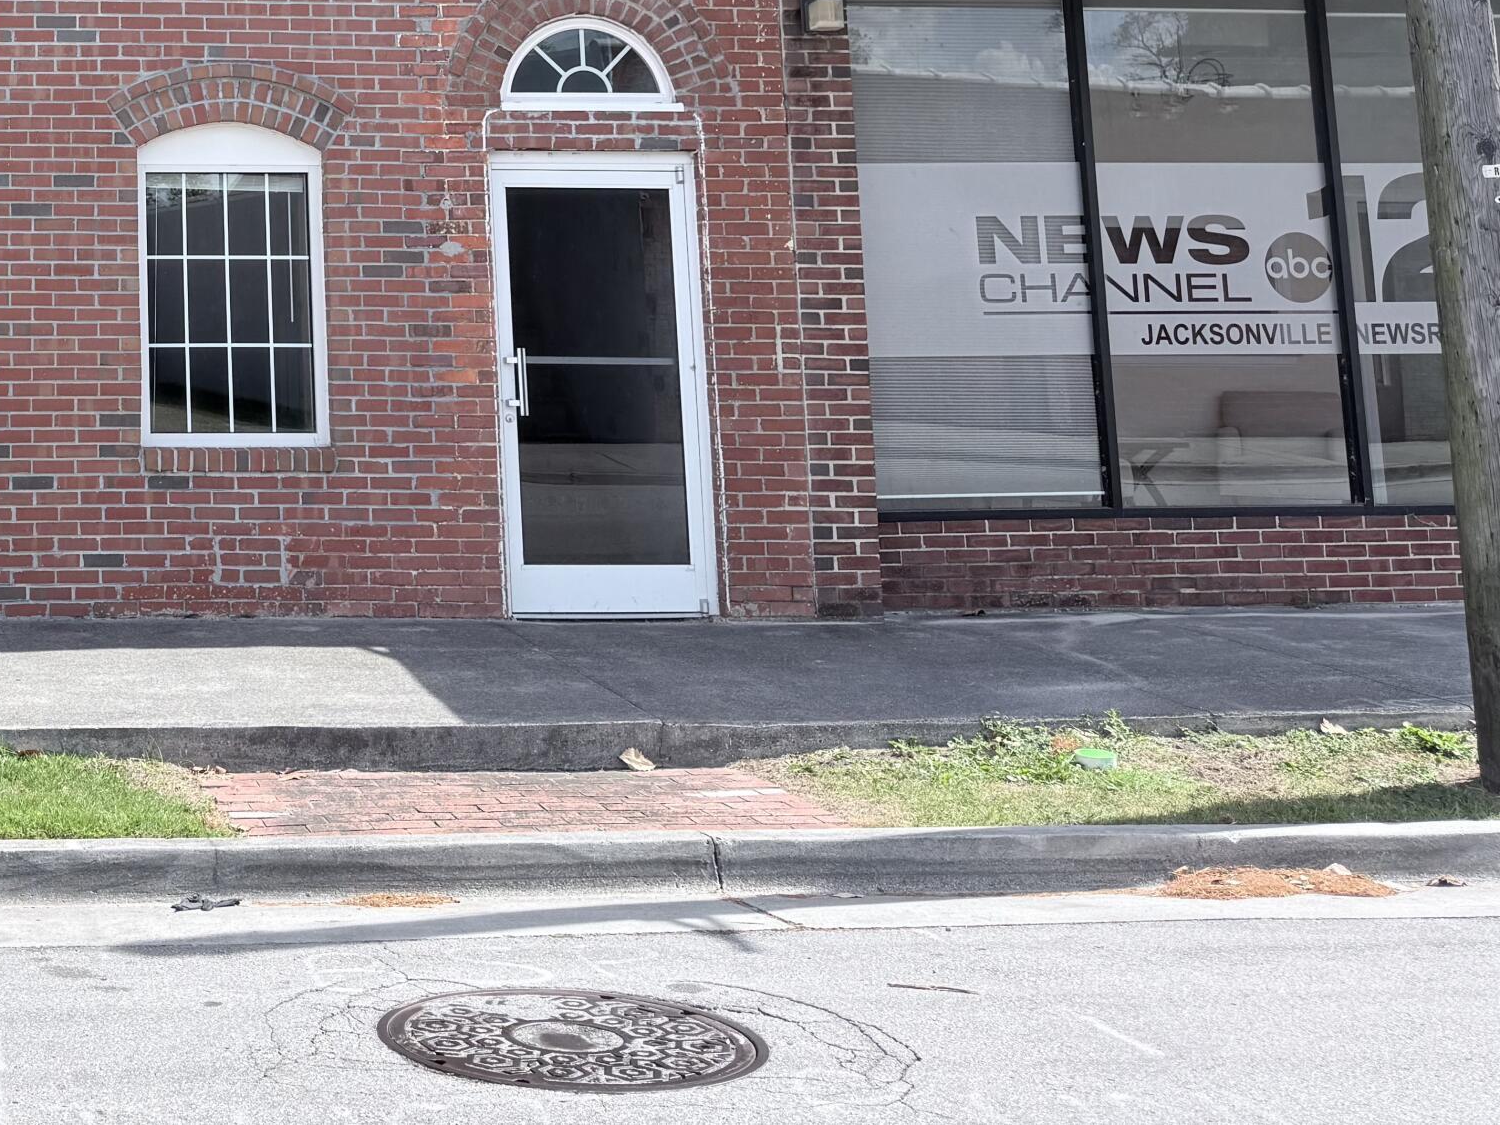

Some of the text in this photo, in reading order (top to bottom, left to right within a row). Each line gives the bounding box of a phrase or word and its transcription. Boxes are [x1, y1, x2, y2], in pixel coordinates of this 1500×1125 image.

[975, 214, 1250, 265] NEWS
[1266, 248, 1333, 279] abc
[979, 273, 1252, 303] CHANNEL
[1141, 323, 1333, 346] JACKSONVILLE
